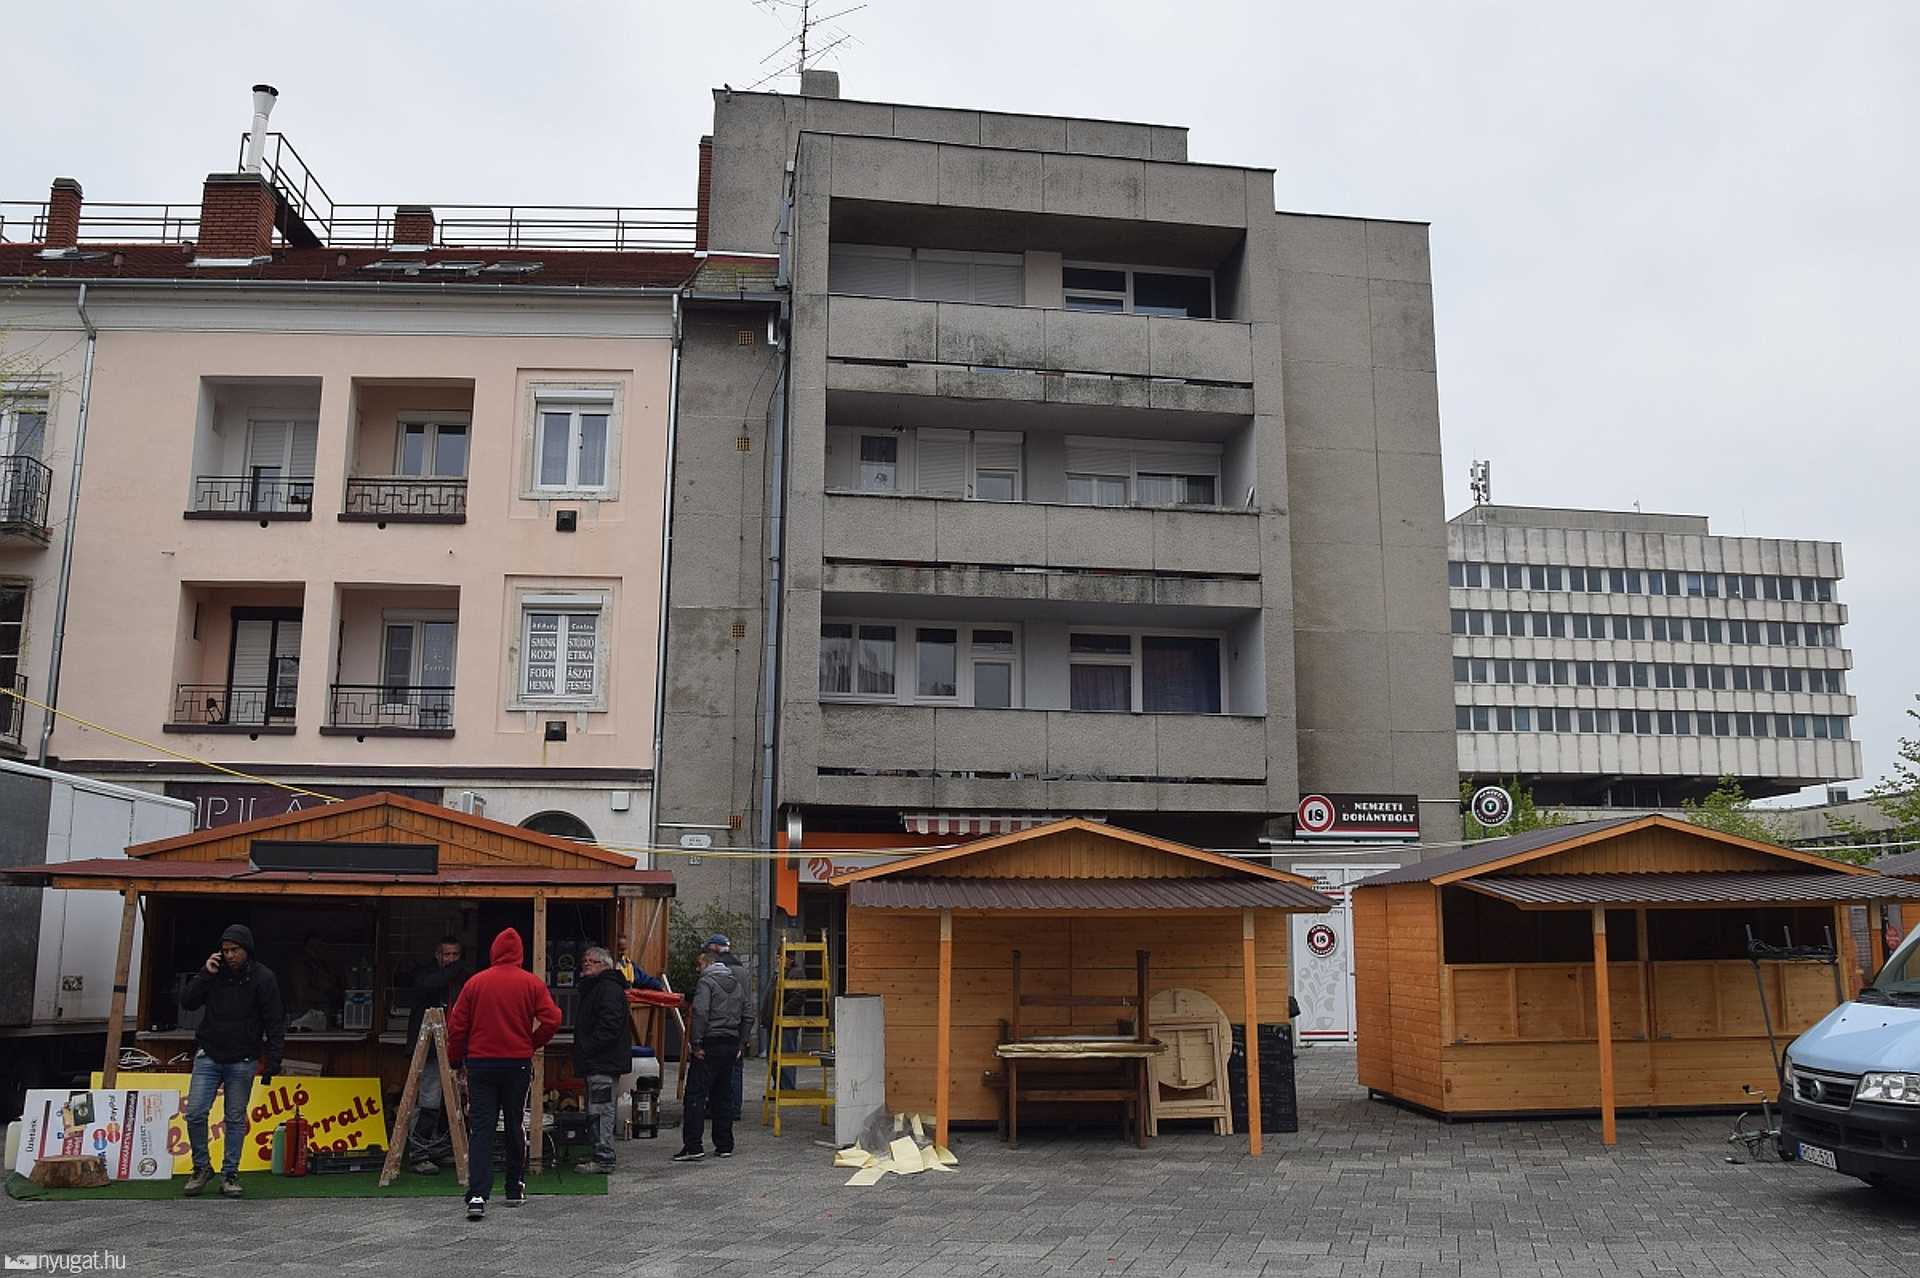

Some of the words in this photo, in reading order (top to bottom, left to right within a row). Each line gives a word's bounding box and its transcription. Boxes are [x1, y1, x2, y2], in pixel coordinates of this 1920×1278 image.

[1354, 802, 1403, 811] NEMZETI
[1308, 809, 1324, 821] 18
[1342, 812, 1416, 822] DOHÁNYBOLT
